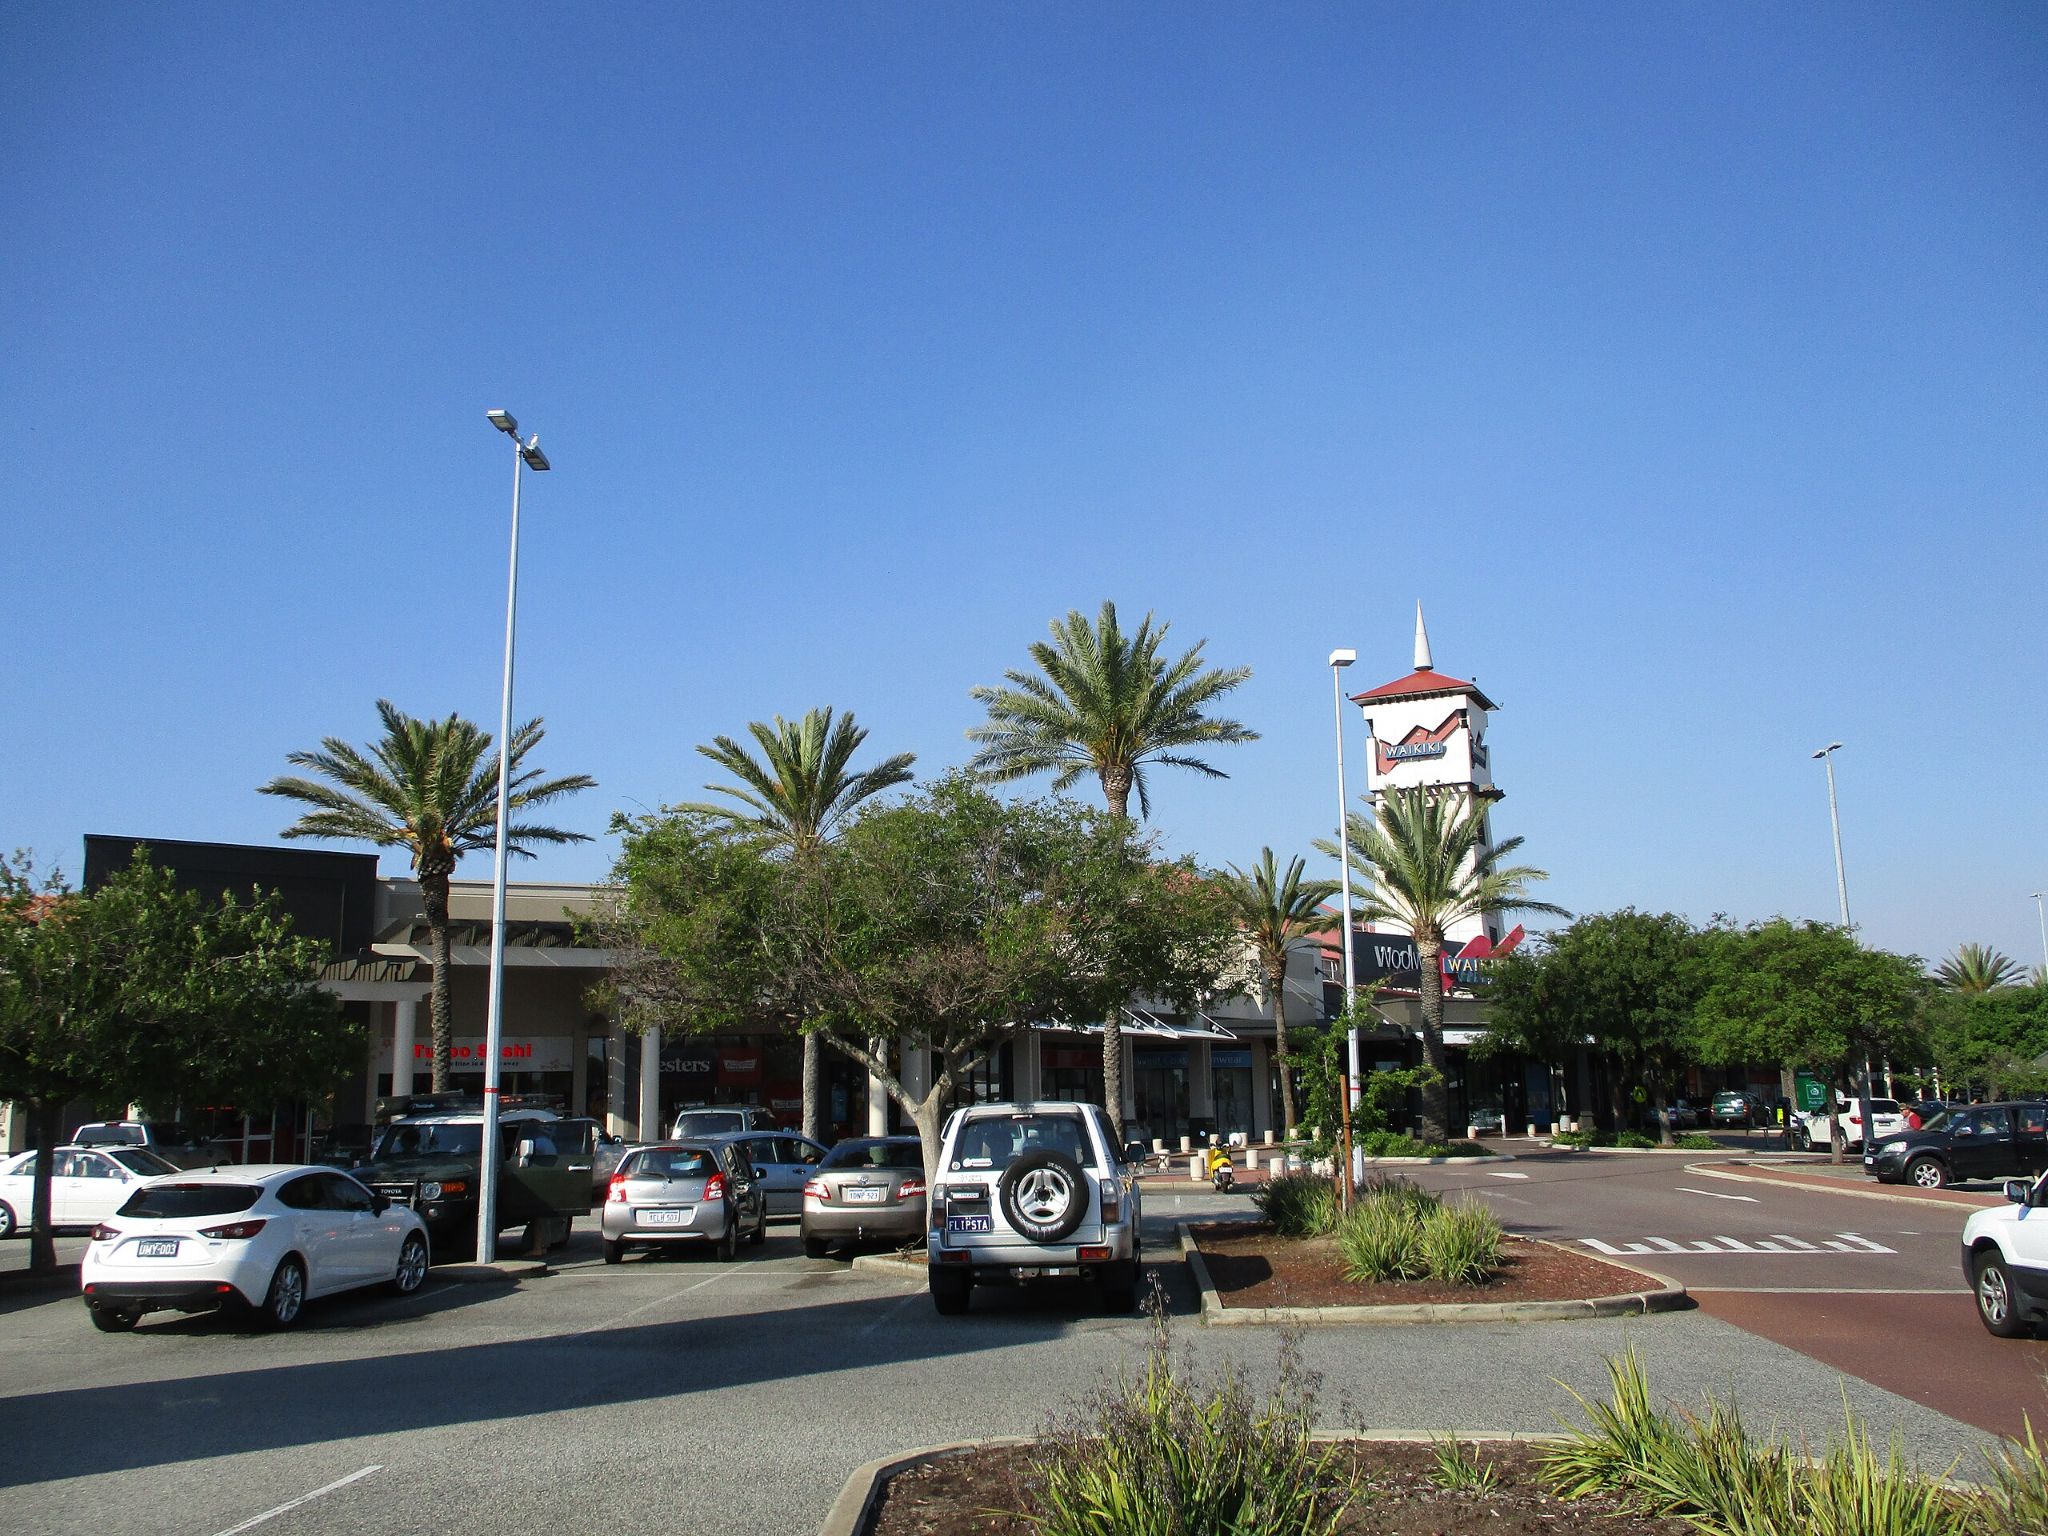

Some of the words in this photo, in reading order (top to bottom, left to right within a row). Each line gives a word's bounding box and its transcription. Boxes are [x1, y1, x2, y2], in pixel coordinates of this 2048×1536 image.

[1386, 743, 1440, 756] WAIKIKI
[414, 1045, 470, 1058] Tuo
[477, 1043, 532, 1058] Sshi
[949, 1221, 988, 1230] FLIPSTA
